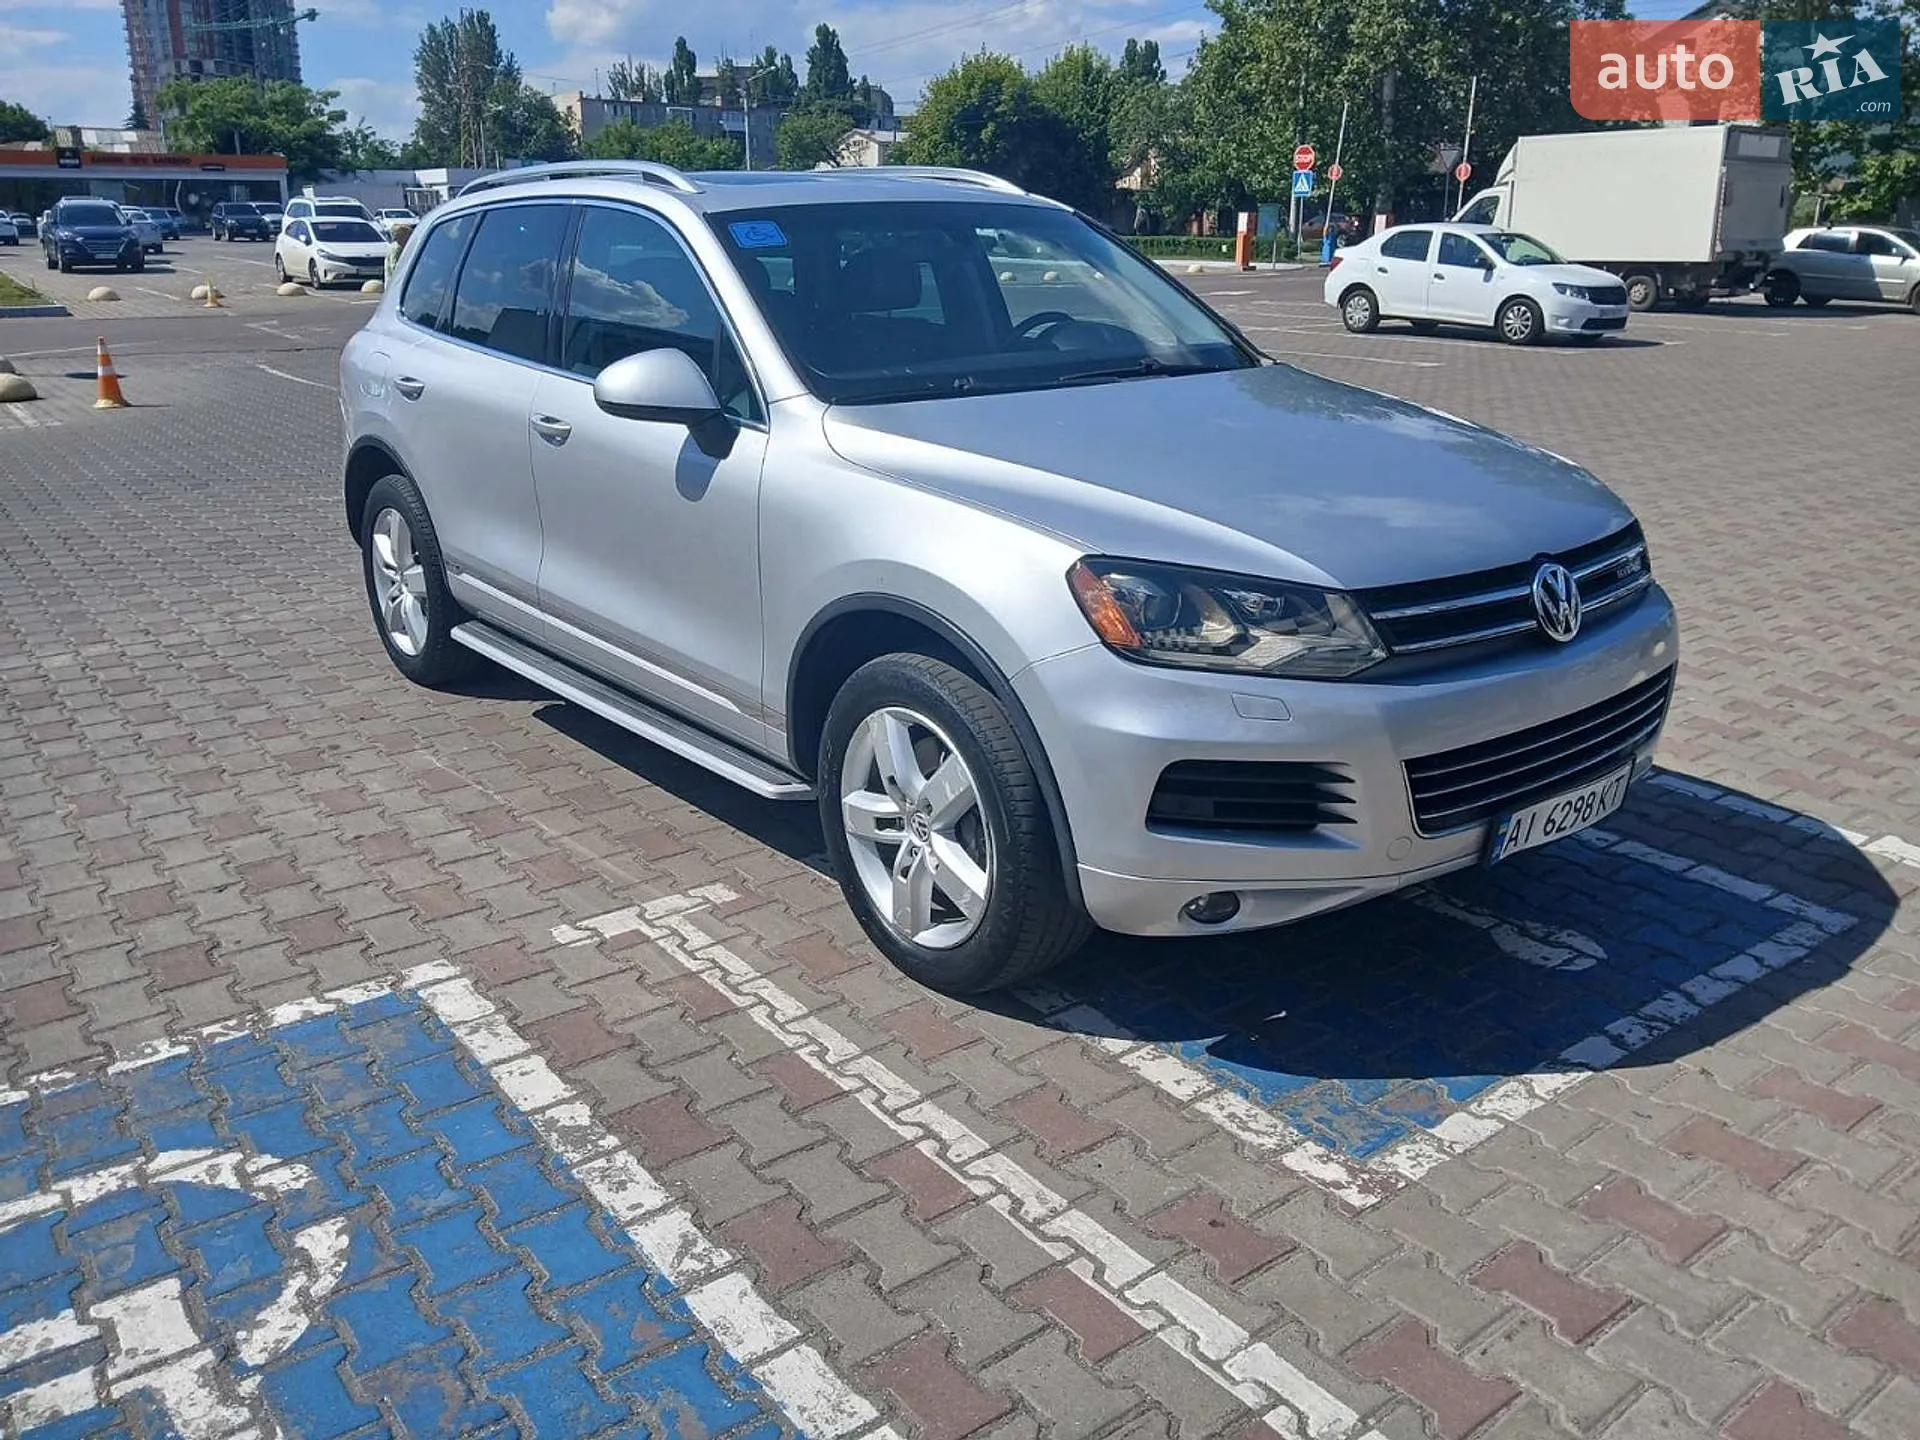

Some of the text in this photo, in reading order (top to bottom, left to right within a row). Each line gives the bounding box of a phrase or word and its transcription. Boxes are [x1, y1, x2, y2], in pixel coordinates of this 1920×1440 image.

[1502, 775, 1626, 853] AI 6298 KT
